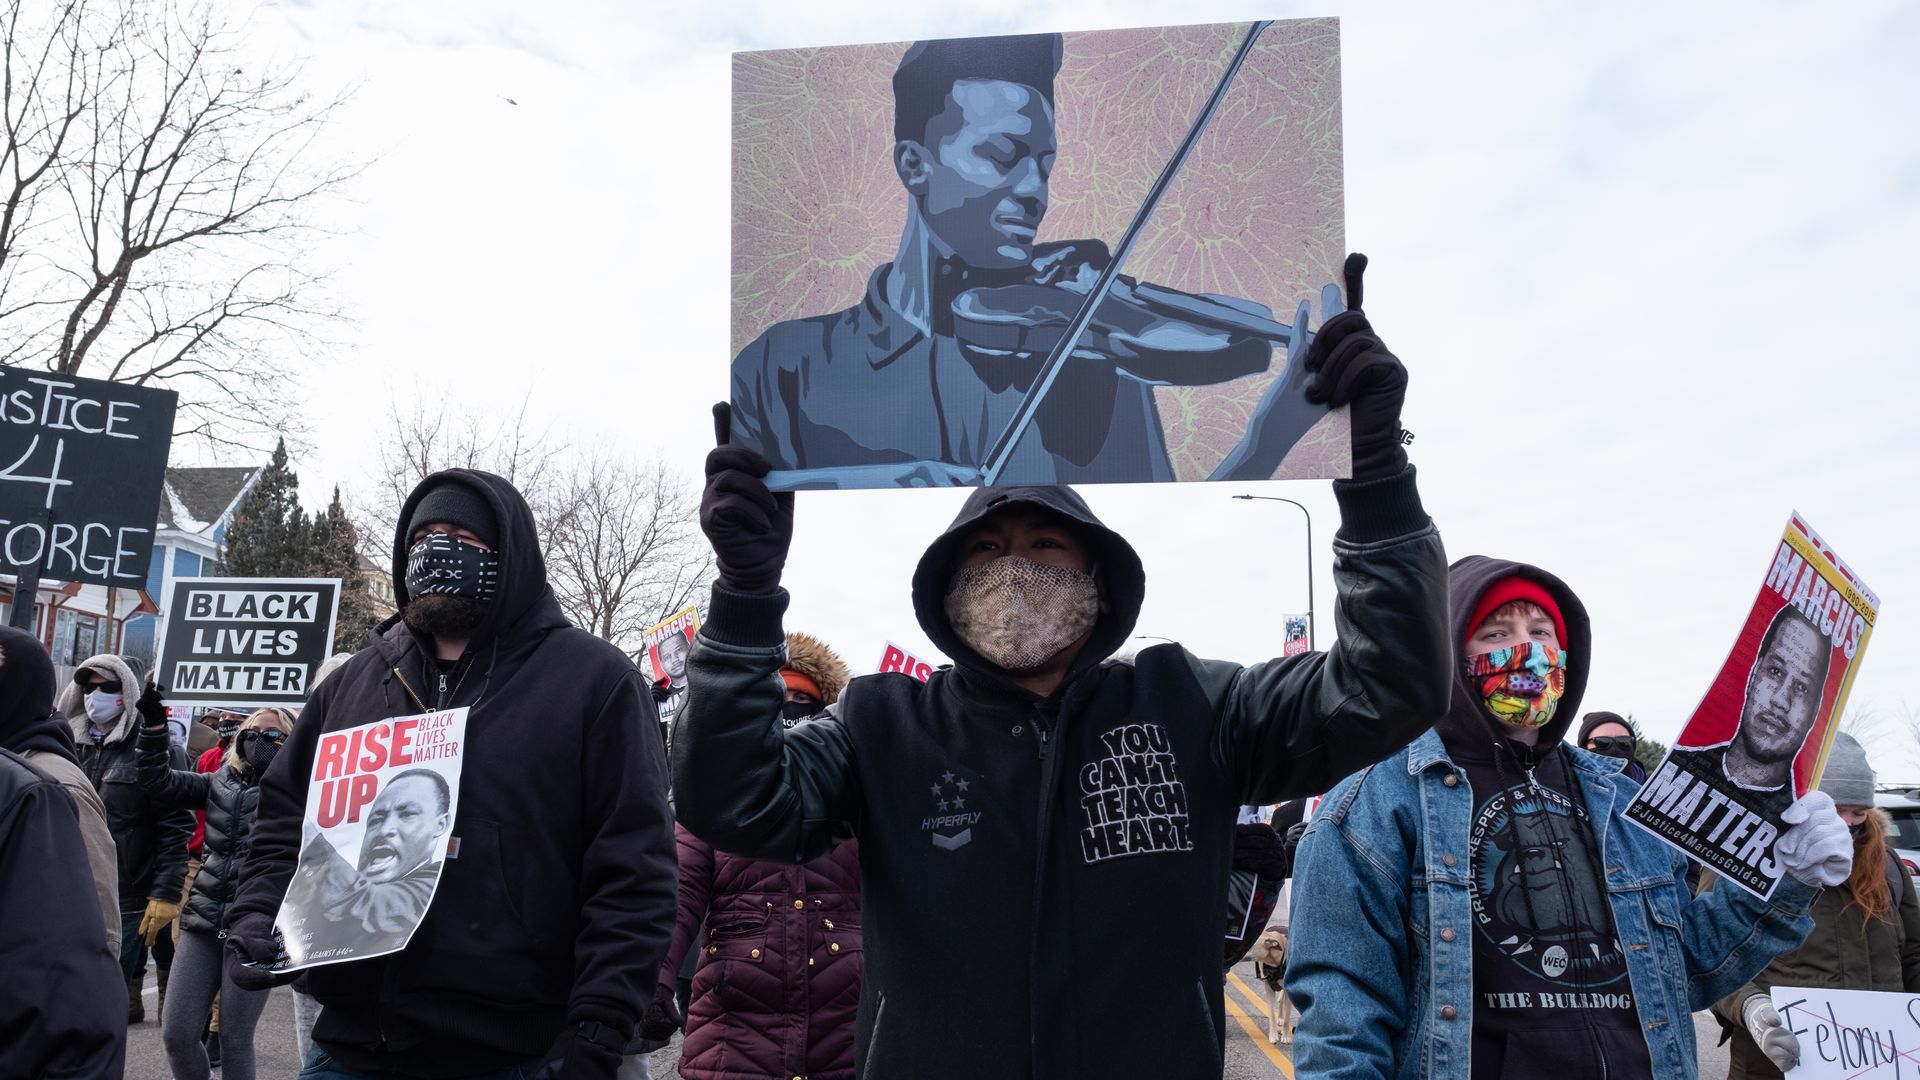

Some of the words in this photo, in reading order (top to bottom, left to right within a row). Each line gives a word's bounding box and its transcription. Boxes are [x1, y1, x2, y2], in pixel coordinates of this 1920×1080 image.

[0, 376, 141, 439] STICE
[0, 434, 73, 509] 4
[0, 520, 149, 579] ORGE
[190, 593, 312, 620] BLACK
[1766, 542, 1866, 660] MARCUS
[1845, 586, 1876, 623] 1990-2015
[192, 629, 298, 656] LIVES
[646, 612, 694, 649] MARCUS
[175, 665, 303, 691] MATTER
[879, 644, 933, 683] RIS
[416, 728, 446, 746] LIVES
[419, 712, 454, 731] BLACK
[314, 719, 419, 782] RISE
[414, 742, 458, 763] MATTER
[1100, 723, 1171, 758] YOU
[1080, 753, 1176, 795] CAN'T
[317, 774, 379, 829] UP
[1080, 782, 1188, 828] TEACH
[1513, 790, 1526, 800] &
[921, 811, 982, 830] HYPERFLY
[1640, 760, 1781, 879] MATTERS
[1631, 804, 1767, 890] #Justice4MarcusGolden
[309, 949, 336, 960] AGAINST
[1543, 956, 1566, 969] WEC
[1484, 992, 1533, 1009] THE
[1538, 992, 1631, 1009] BULLDOG
[1778, 998, 1901, 1080] Felony
